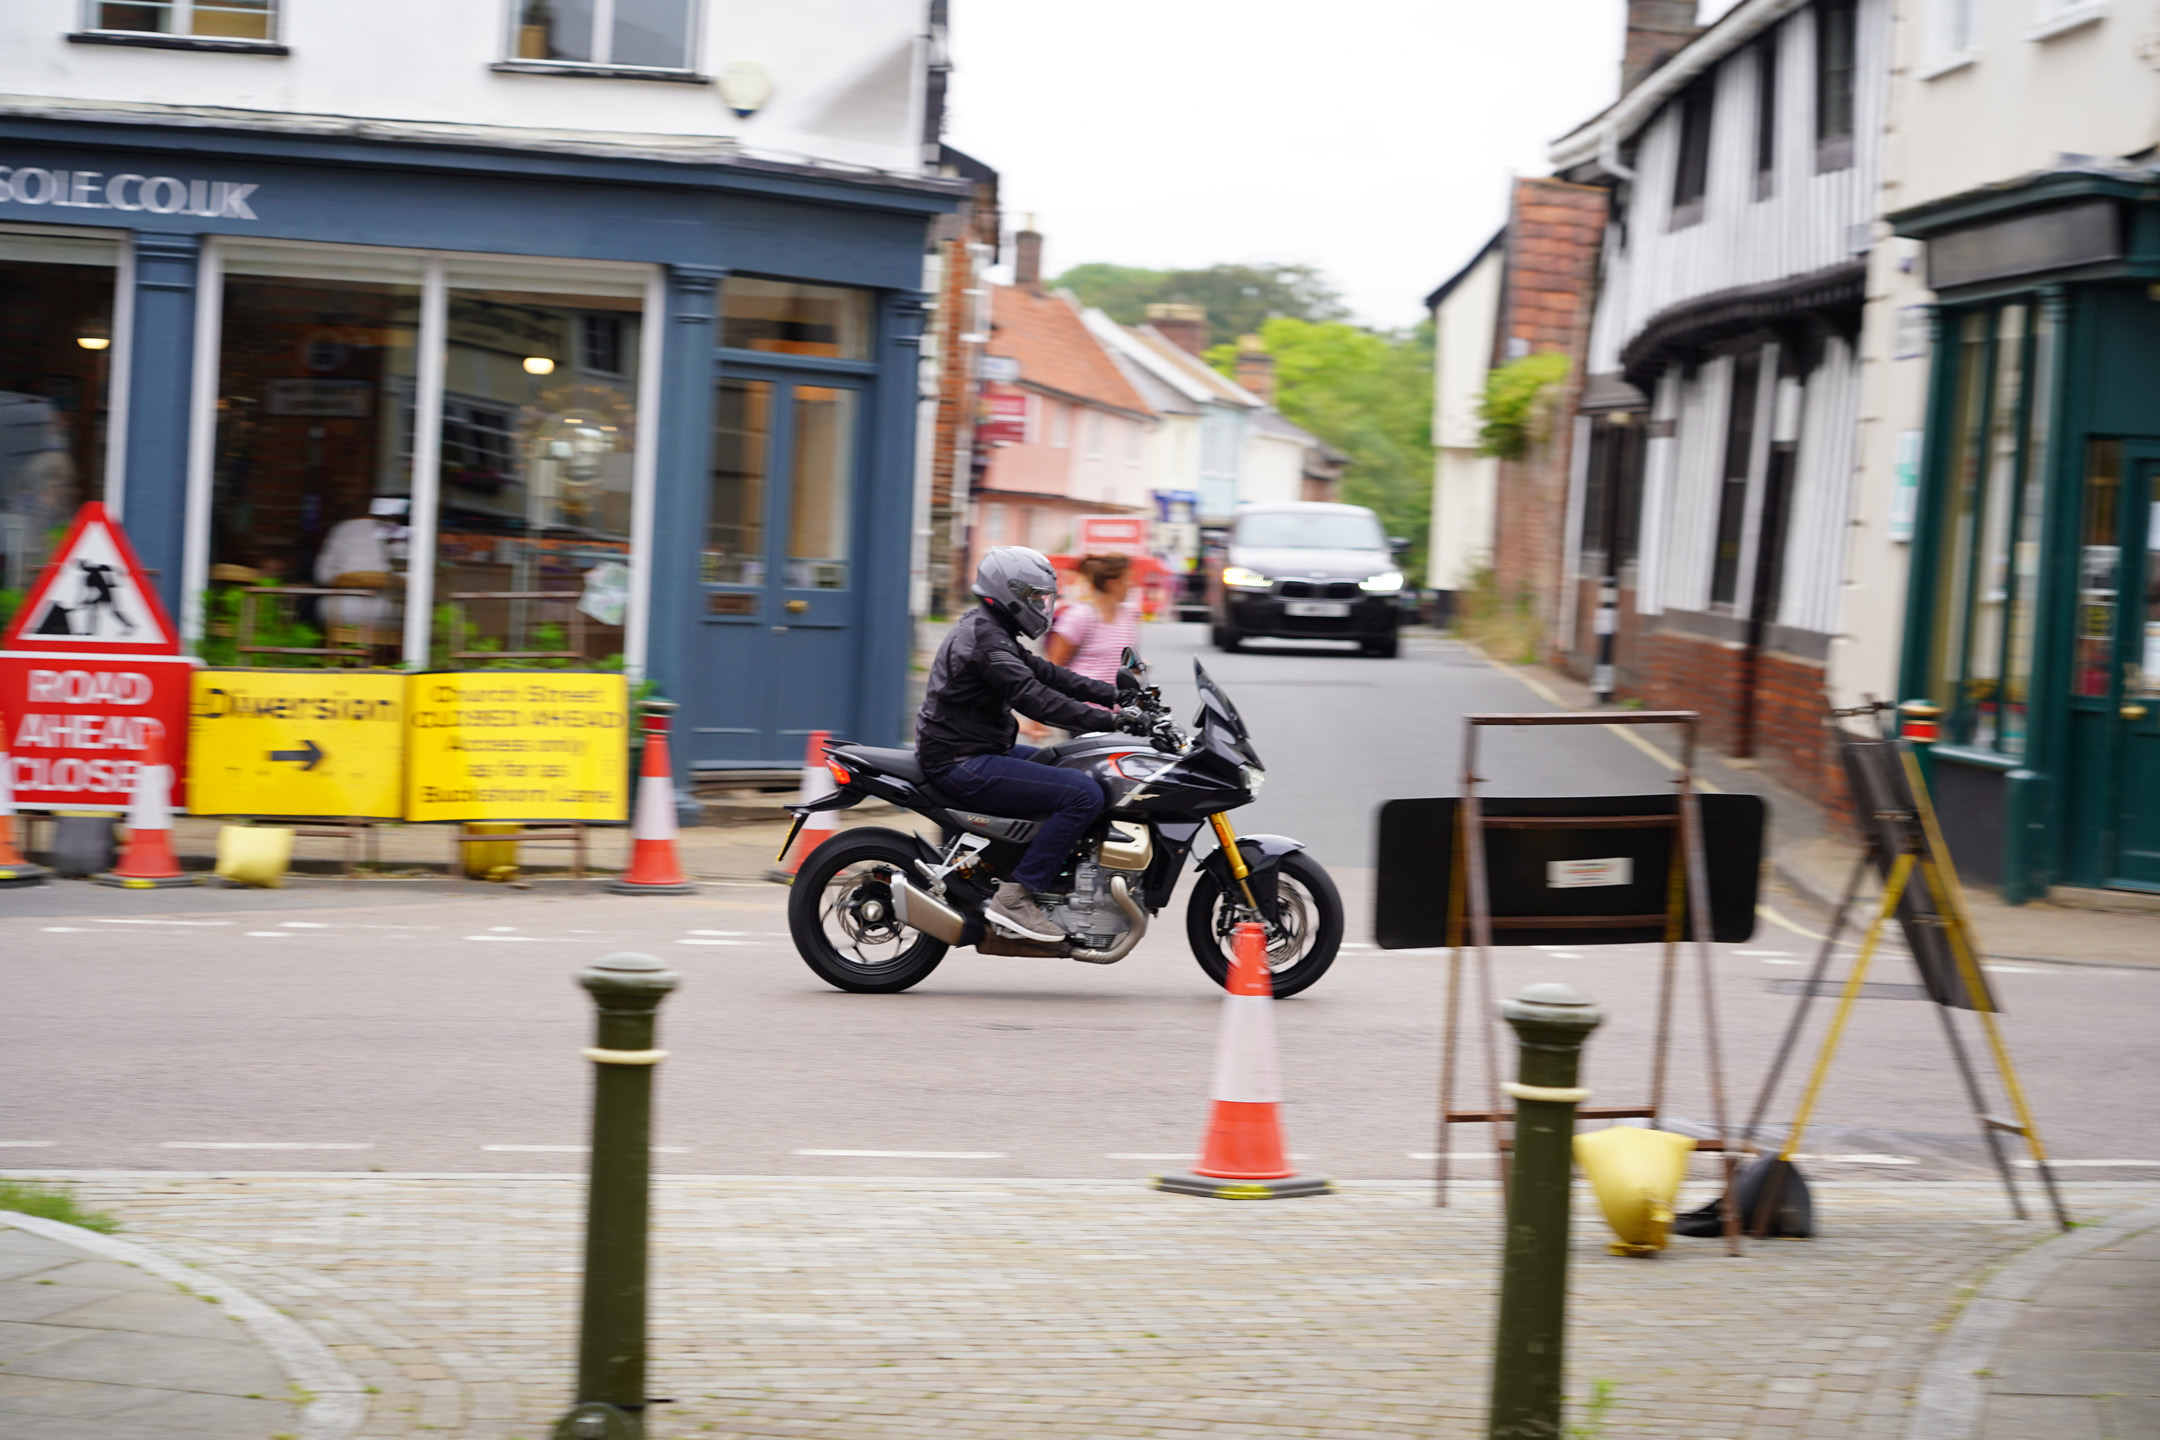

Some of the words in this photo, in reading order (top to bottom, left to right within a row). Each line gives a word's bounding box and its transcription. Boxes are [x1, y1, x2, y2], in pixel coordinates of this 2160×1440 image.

[27, 669, 153, 705] ROAD
[525, 685, 605, 704] Street
[198, 687, 401, 722] Diversion
[13, 713, 166, 750] AHEAD
[411, 710, 522, 728] CLOSED
[529, 710, 627, 728] AHEAD
[967, 814, 990, 824] V100
